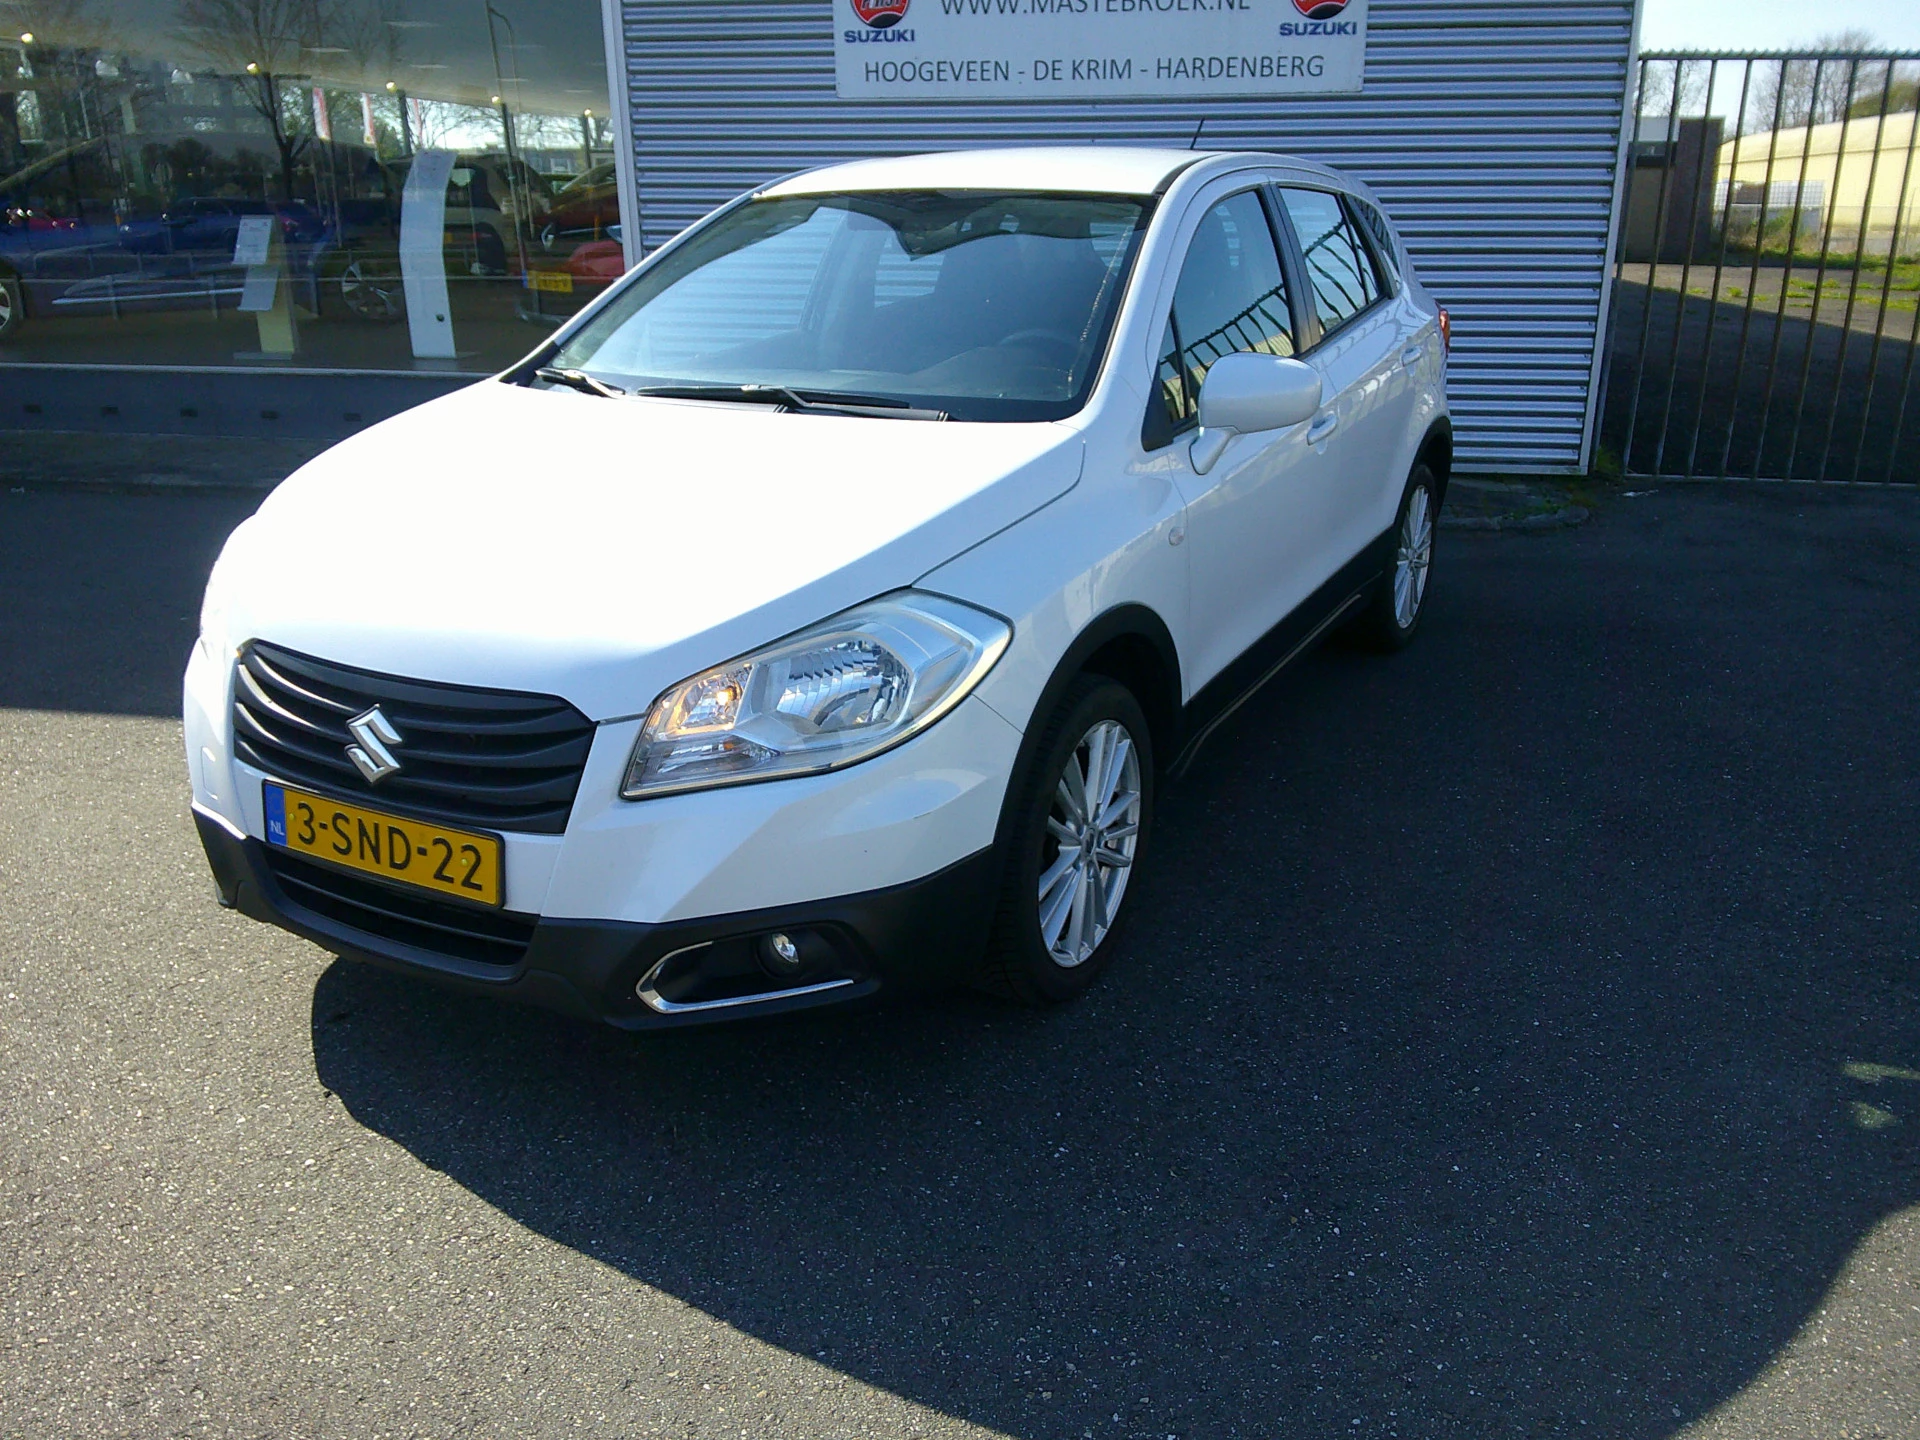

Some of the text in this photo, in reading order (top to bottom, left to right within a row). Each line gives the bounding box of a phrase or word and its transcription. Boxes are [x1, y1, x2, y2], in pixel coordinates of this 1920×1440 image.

[844, 29, 915, 43] SUZUKI
[1279, 21, 1357, 36] SUZUKI
[865, 60, 1010, 82] HOOGEVEEN
[1033, 59, 1063, 81] DE
[1071, 58, 1132, 80] KRIM
[1156, 55, 1325, 79] HARDENBERG
[270, 819, 286, 836] NL
[297, 802, 483, 891] 3-SND-22
